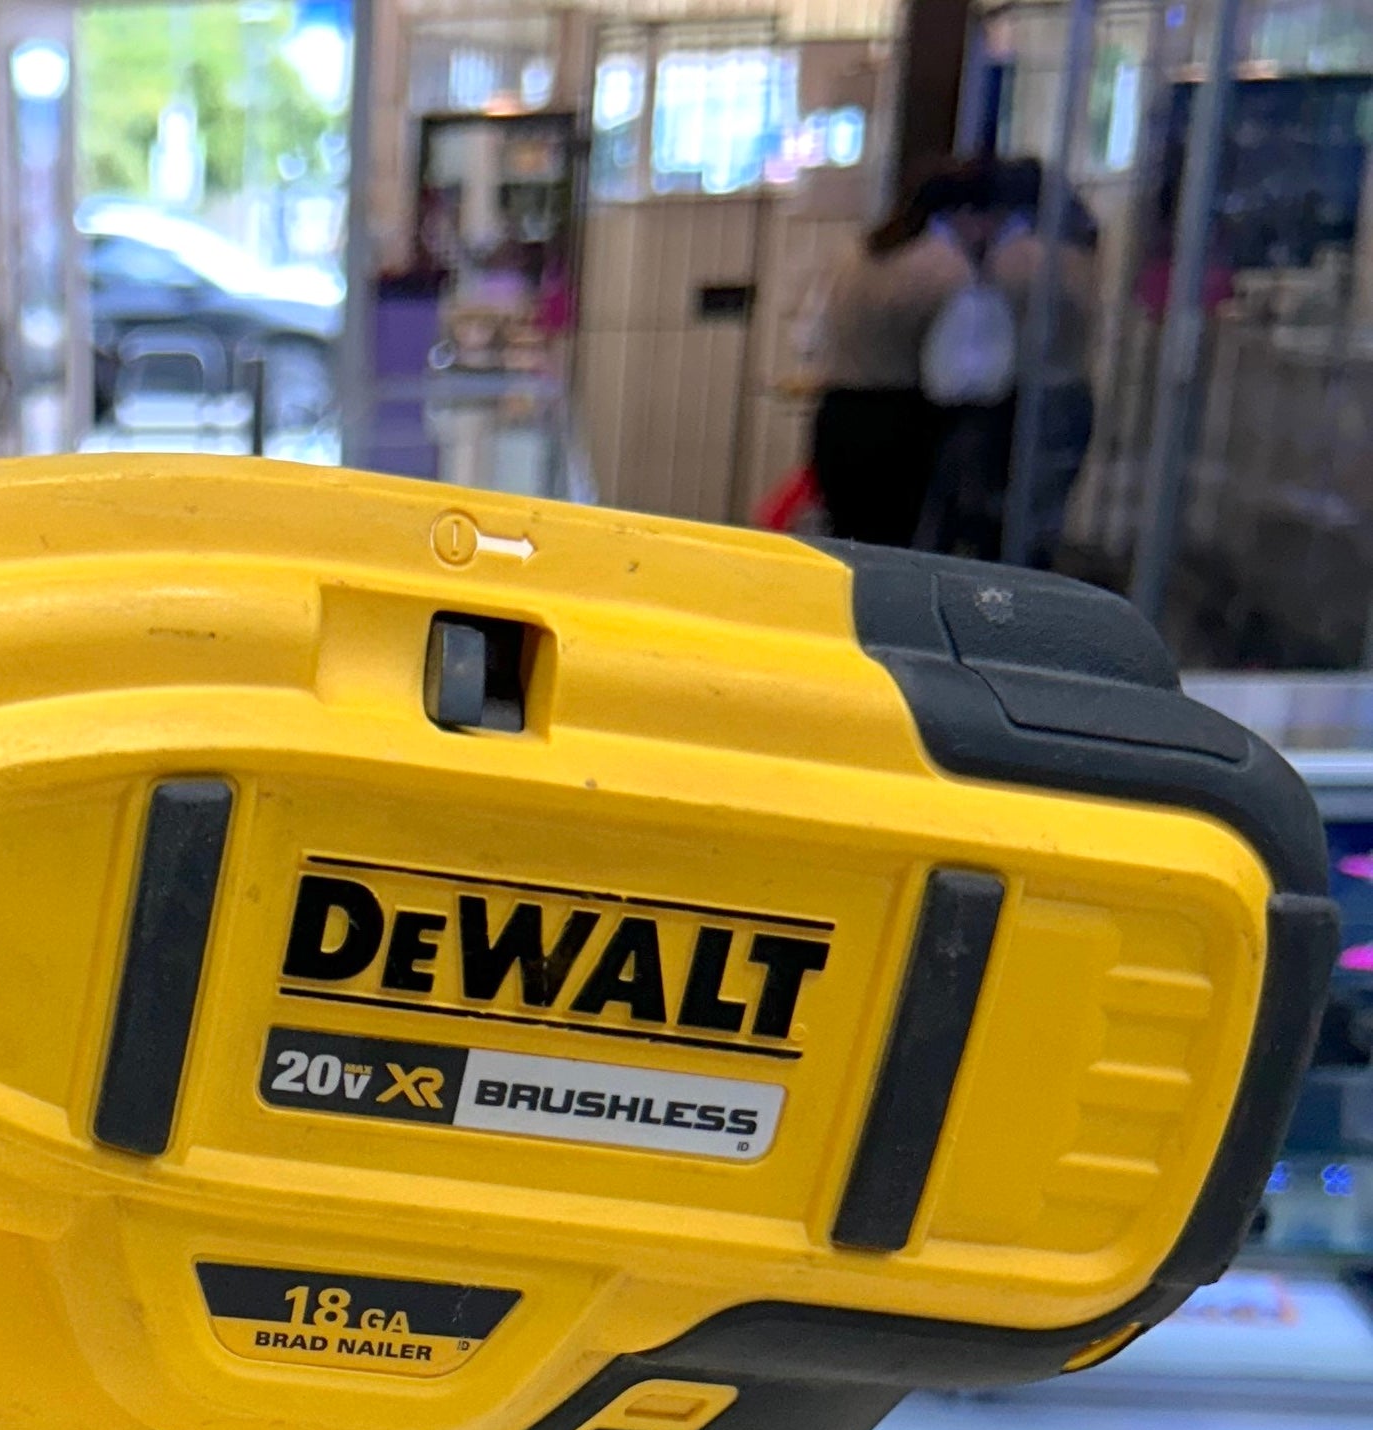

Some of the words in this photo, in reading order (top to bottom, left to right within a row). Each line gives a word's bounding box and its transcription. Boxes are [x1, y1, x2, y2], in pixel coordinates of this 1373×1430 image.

[376, 1062, 444, 1109] XR
[474, 1079, 758, 1136] BRUSHLESS
[284, 1285, 352, 1328] 18
[360, 1308, 411, 1334] GA
[255, 1331, 328, 1351] BRAD
[337, 1338, 433, 1361] NAILER
